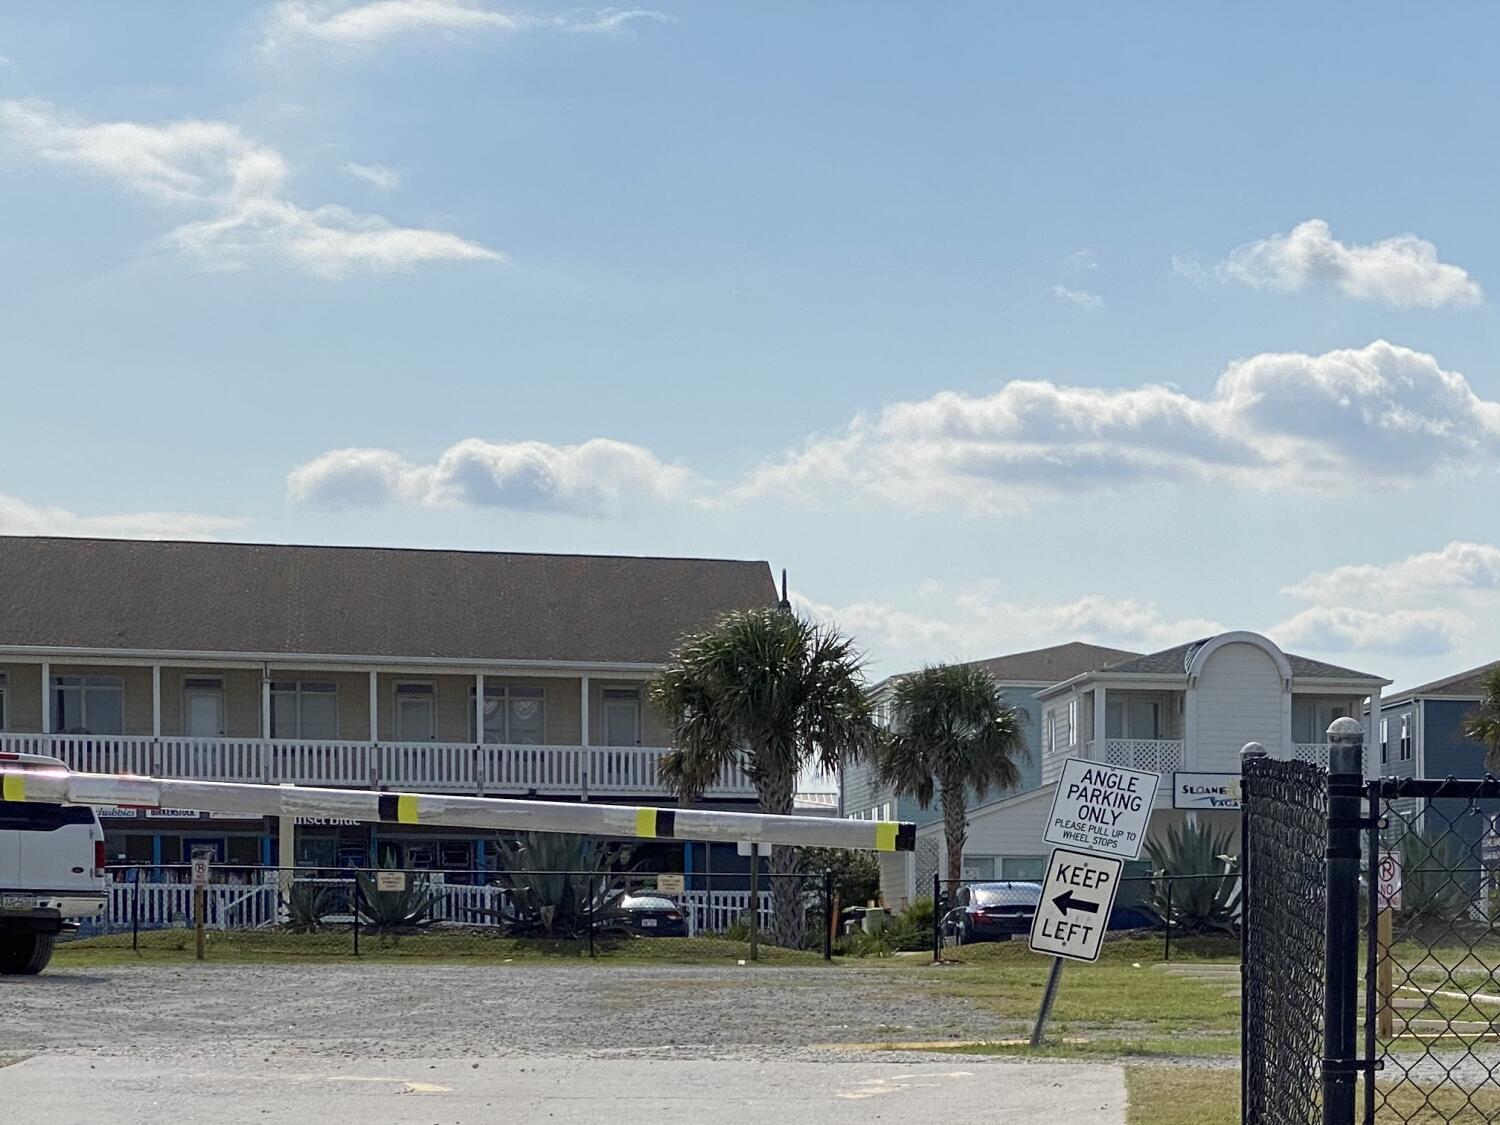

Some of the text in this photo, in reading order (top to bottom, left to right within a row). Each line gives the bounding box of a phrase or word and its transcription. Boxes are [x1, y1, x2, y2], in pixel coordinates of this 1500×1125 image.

[1081, 769, 1139, 793] ANGLE
[1182, 784, 1227, 795] SLOANE
[1067, 784, 1143, 812] PARKING
[1078, 805, 1123, 826] ONLY
[1055, 819, 1137, 842] PLEASE PULL UP TO
[1062, 830, 1118, 848] WHEEL STOPS
[1055, 863, 1110, 889] KEEP
[1381, 883, 1393, 895] NO
[1042, 918, 1093, 945] LEFT
